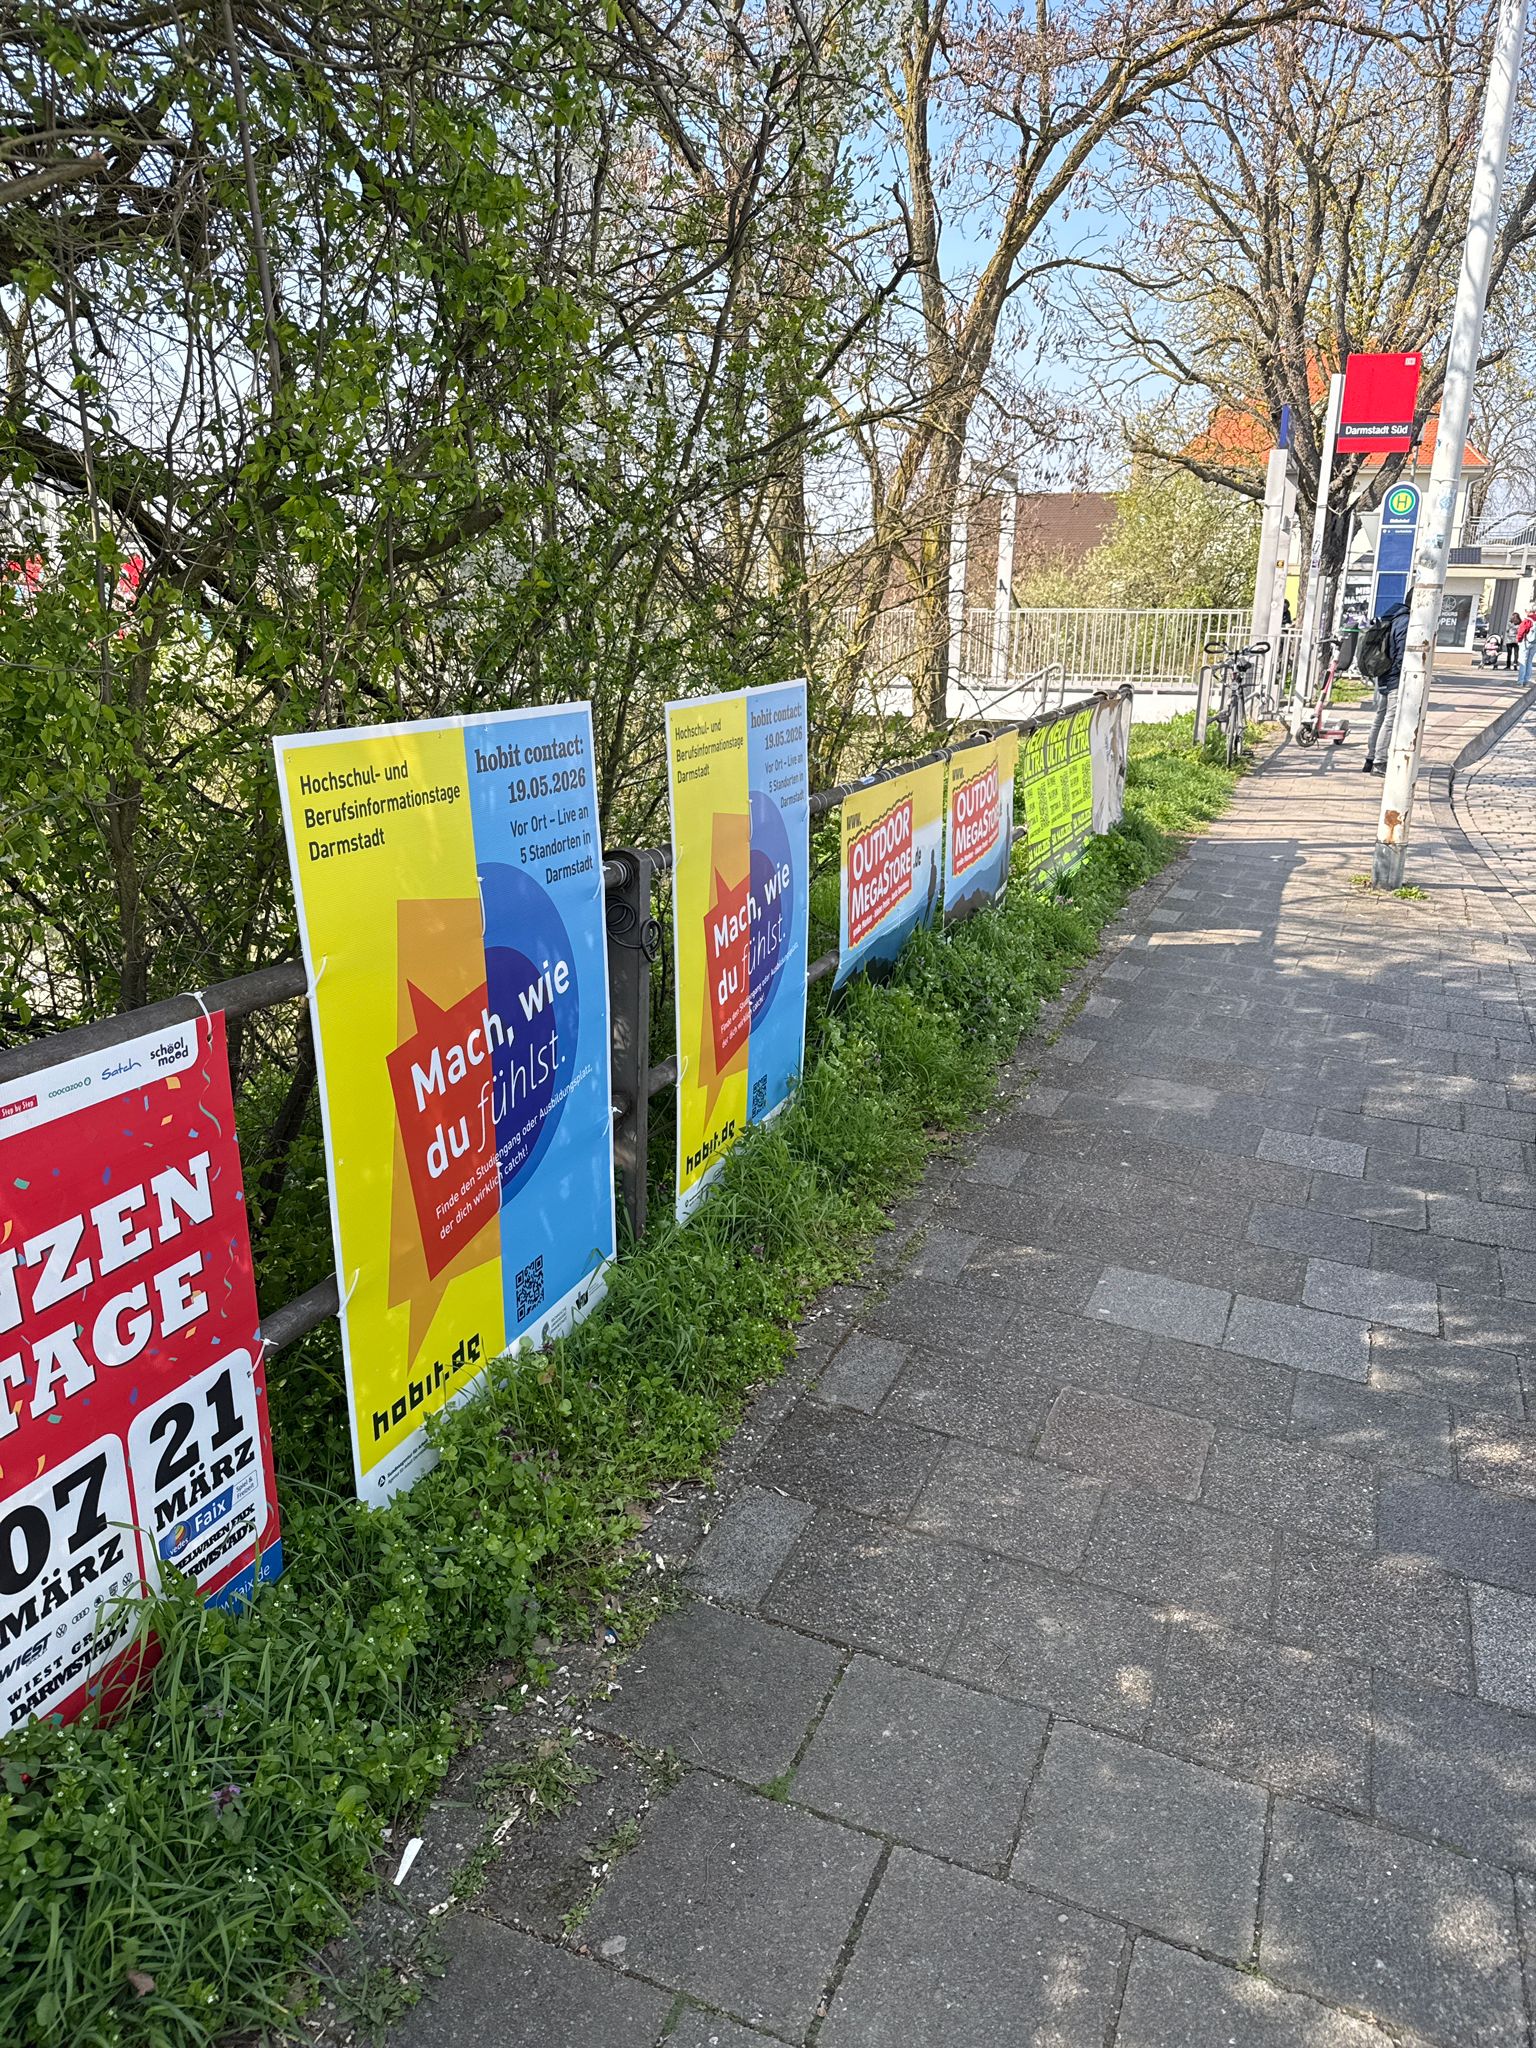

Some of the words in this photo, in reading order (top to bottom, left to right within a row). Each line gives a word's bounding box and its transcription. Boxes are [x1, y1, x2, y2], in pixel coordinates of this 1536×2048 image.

[1345, 425, 1389, 435] Darmstadt
[1391, 424, 1409, 434] Süd
[675, 722, 709, 741] Hochschul-
[711, 719, 722, 732] und
[750, 707, 772, 729] hobit
[475, 744, 522, 773] hobit
[525, 734, 584, 765] contact:
[676, 736, 744, 763] Berufsinformationstage
[764, 727, 803, 751] 19.05.2026
[300, 765, 381, 796] Hochschul-
[385, 760, 409, 782] und
[677, 764, 710, 784] Darmstadt
[765, 761, 774, 775] Vor
[775, 759, 783, 771] Ort
[788, 754, 797, 767] Live
[769, 781, 773, 793] 5
[773, 775, 799, 792] Standorten
[507, 767, 586, 803] 19.05.2026
[780, 791, 805, 809] Darmstadt
[304, 784, 461, 829] Berufsinformationstage
[510, 820, 528, 838] Vor
[531, 814, 547, 833] Ort
[558, 808, 577, 826] Live
[578, 805, 589, 820] an
[308, 828, 386, 861] Darmstadt
[520, 847, 527, 864] 5
[530, 835, 581, 862] Standorten
[583, 830, 591, 845] in
[853, 805, 910, 881] OUTDOOR
[546, 855, 594, 885] Darmstadt
[851, 846, 911, 923] MEGASTORE
[713, 892, 762, 959] Mach,
[764, 862, 789, 905] wie
[717, 965, 738, 1006] du
[740, 913, 786, 993] fühlst.
[410, 1008, 514, 1113] Mach,
[518, 959, 570, 1022] wie
[49, 1081, 83, 1099] coocazoo
[426, 1115, 471, 1179] du
[477, 1029, 566, 1153] fühlst.
[436, 1191, 460, 1220] Finde
[460, 1175, 475, 1195] den
[476, 1132, 521, 1180] Studiengang
[522, 1114, 538, 1135] oder
[539, 1063, 593, 1120] Ausbildungsplatz,
[686, 1119, 735, 1176] hobit.de
[440, 1219, 454, 1240] der
[455, 1201, 473, 1225] dich
[472, 1172, 504, 1204] wirklich
[504, 1143, 529, 1175] catcht!
[372, 1332, 481, 1442] hobit.de
[149, 1368, 244, 1493] 21
[154, 1436, 255, 1533] MÄRZ
[0, 1452, 108, 1595] 07
[194, 1499, 227, 1533] Faix
[169, 1538, 190, 1555] vedes
[0, 1533, 124, 1650] MÄRZ
[0, 1632, 52, 1684] WIEST
[10, 1617, 129, 1726] DARMSTADT
[7, 1655, 63, 1705] WIEST
